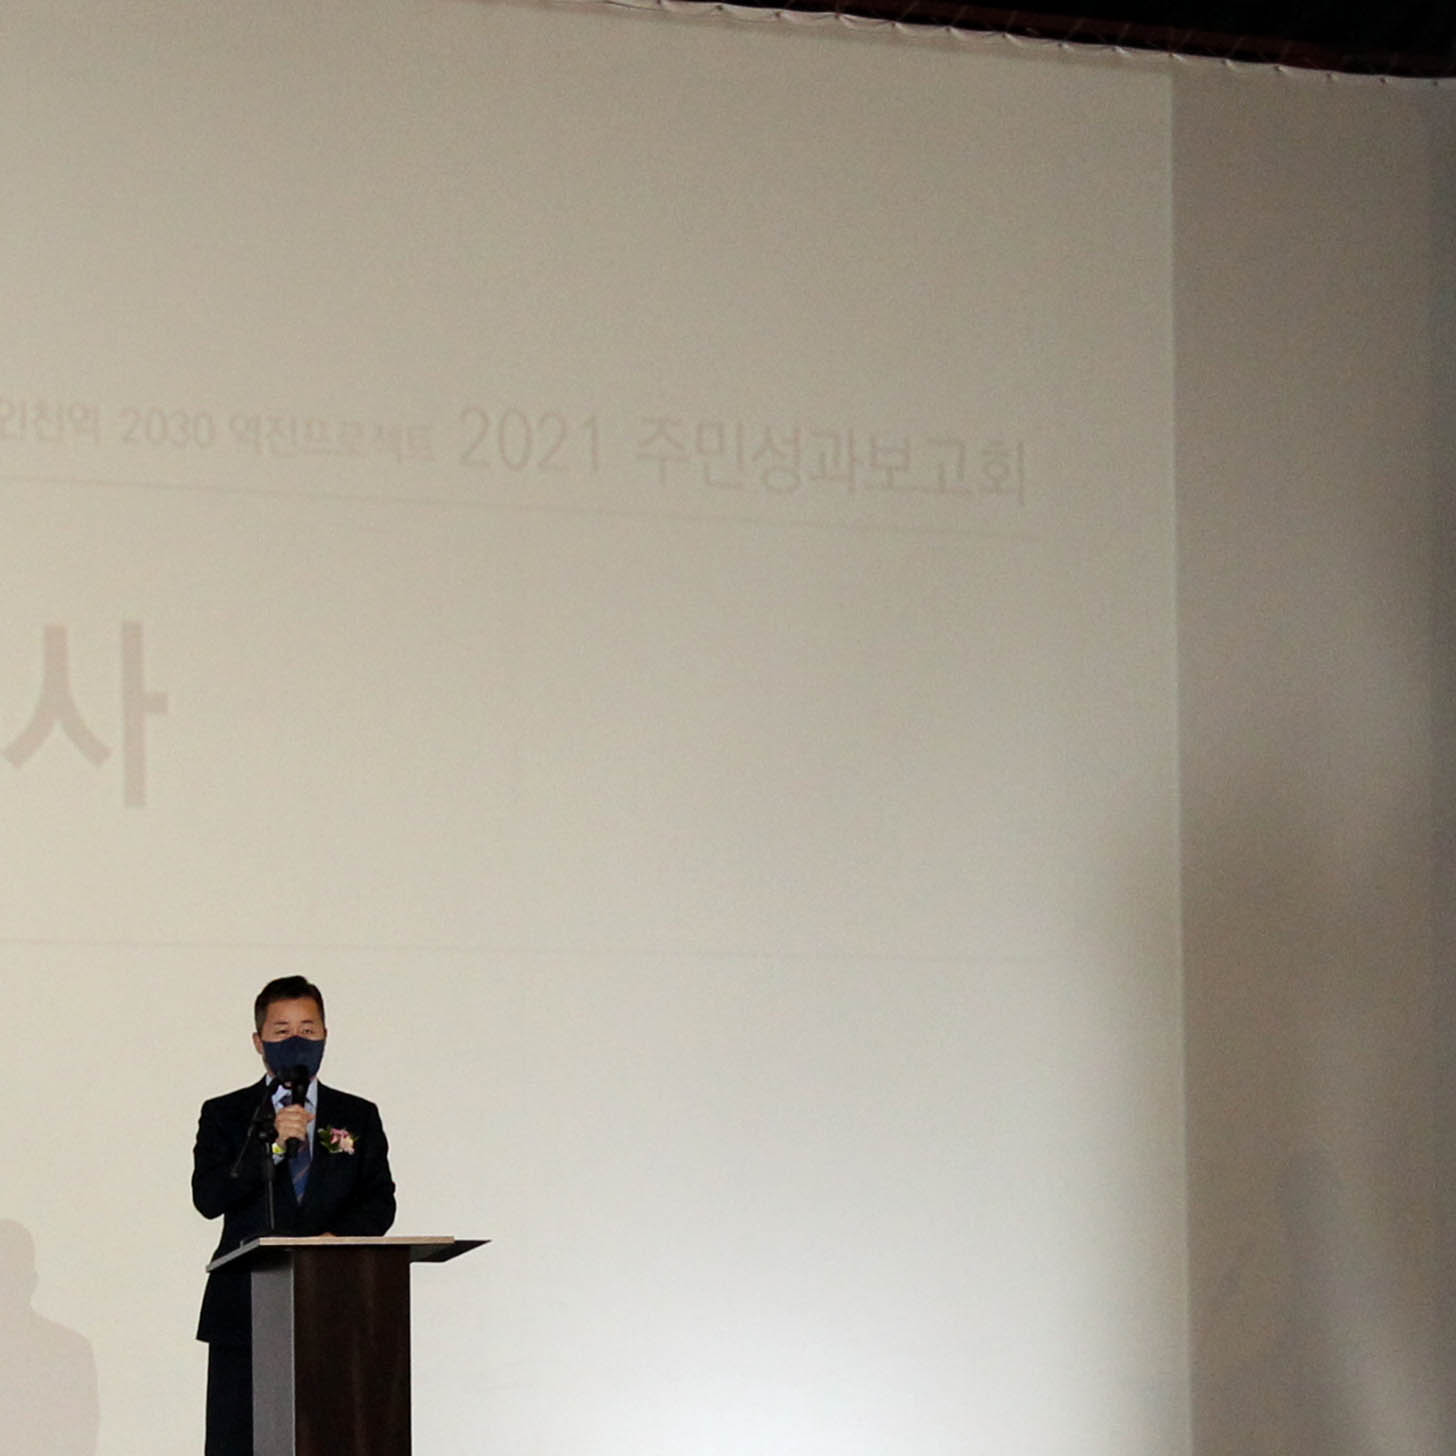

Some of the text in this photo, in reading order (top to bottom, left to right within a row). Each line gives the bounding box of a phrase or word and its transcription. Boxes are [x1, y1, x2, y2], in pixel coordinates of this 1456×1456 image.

[119, 408, 218, 451] 2030
[461, 407, 601, 474] 2021
[635, 414, 1025, 505] 주민성과보고회
